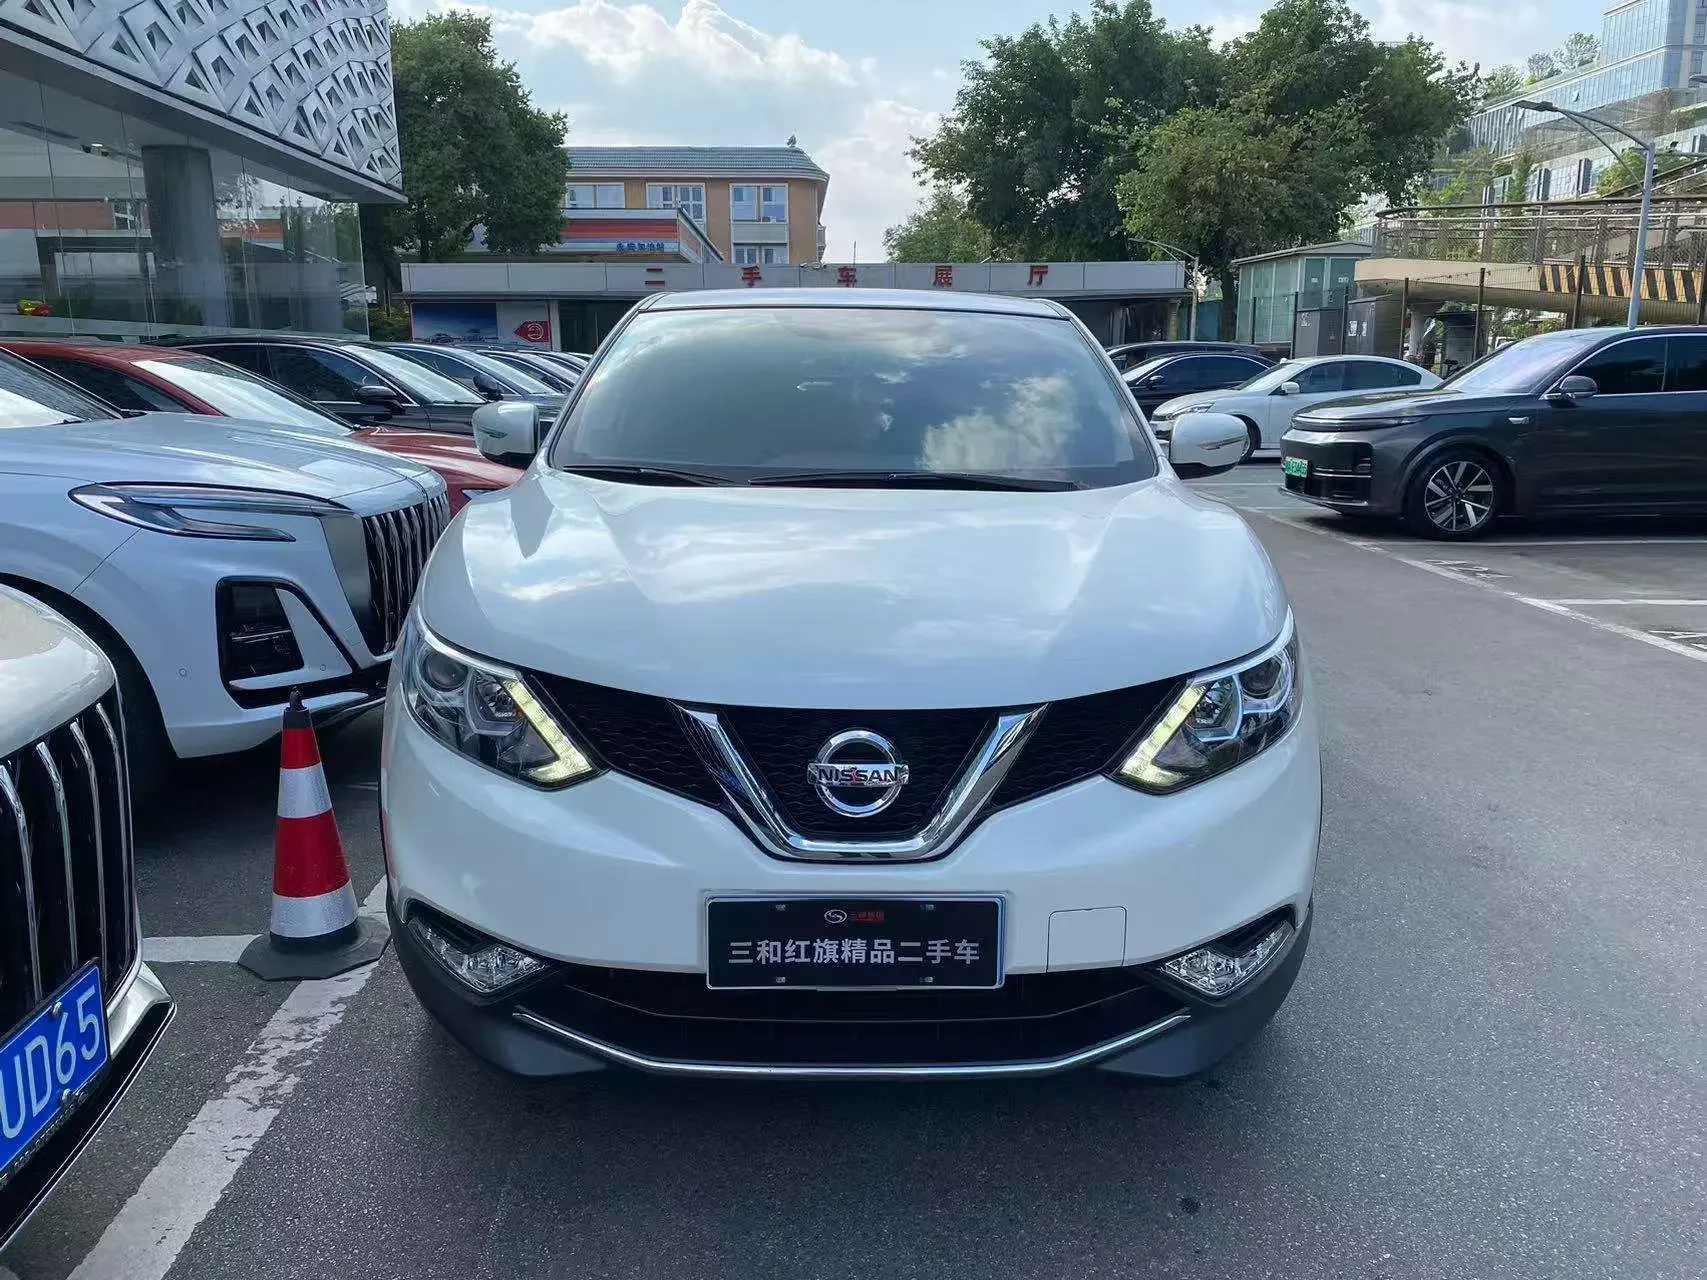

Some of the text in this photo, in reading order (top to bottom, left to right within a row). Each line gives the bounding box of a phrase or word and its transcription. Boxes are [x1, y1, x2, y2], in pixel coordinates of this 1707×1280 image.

[645, 265, 1048, 287] 二手车展厅
[817, 767, 898, 782] NISSAN
[728, 938, 980, 964] 三和红旗精品二手车
